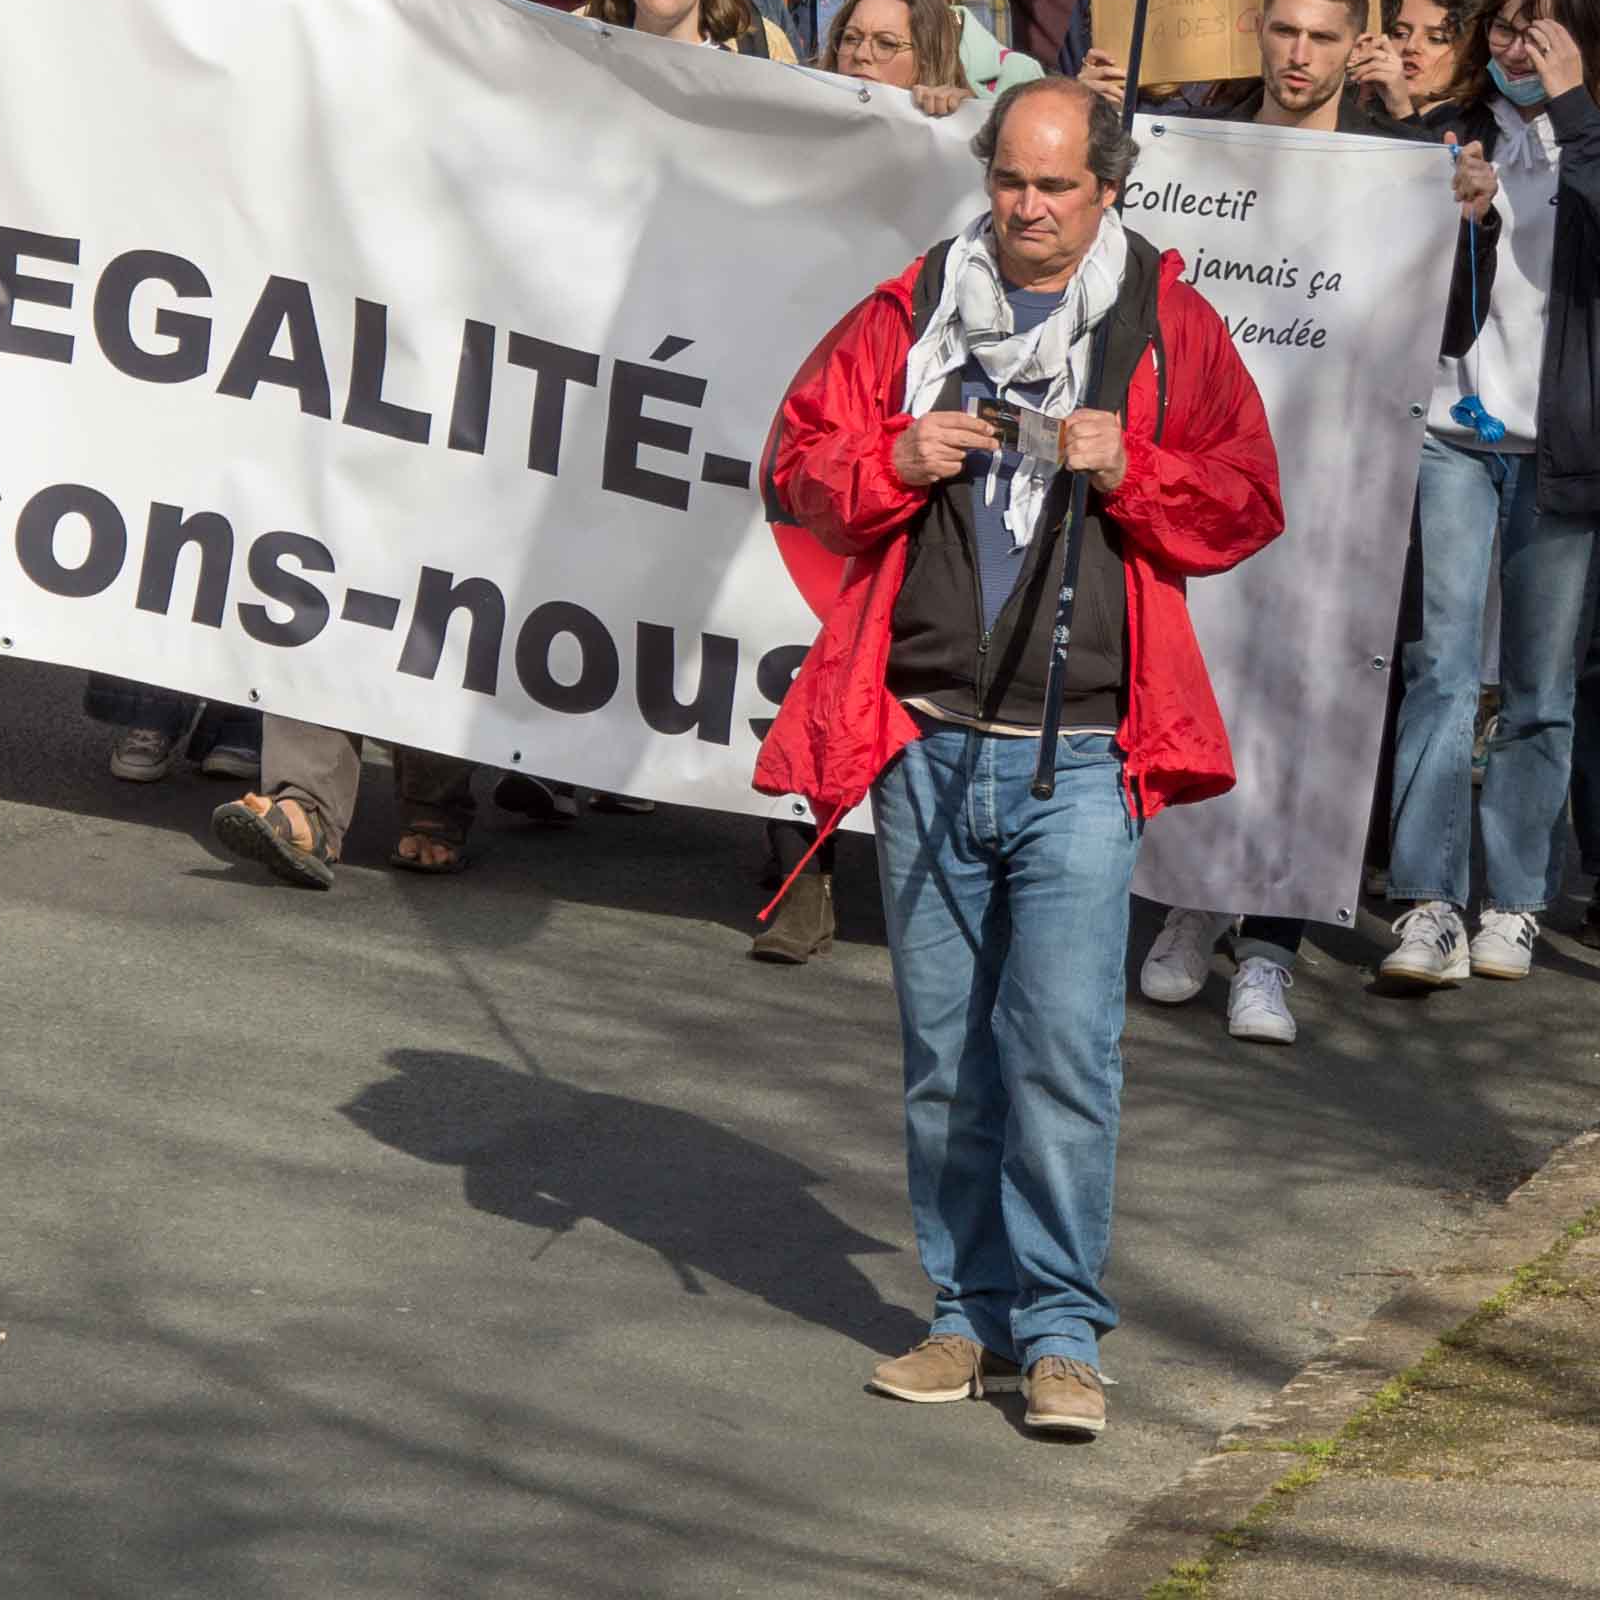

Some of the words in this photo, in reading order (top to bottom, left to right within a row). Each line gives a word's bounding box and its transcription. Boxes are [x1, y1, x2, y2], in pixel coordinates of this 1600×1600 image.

[1123, 182, 1258, 222] Collectif
[1186, 248, 1299, 289] jamais
[1306, 270, 1343, 300] ça
